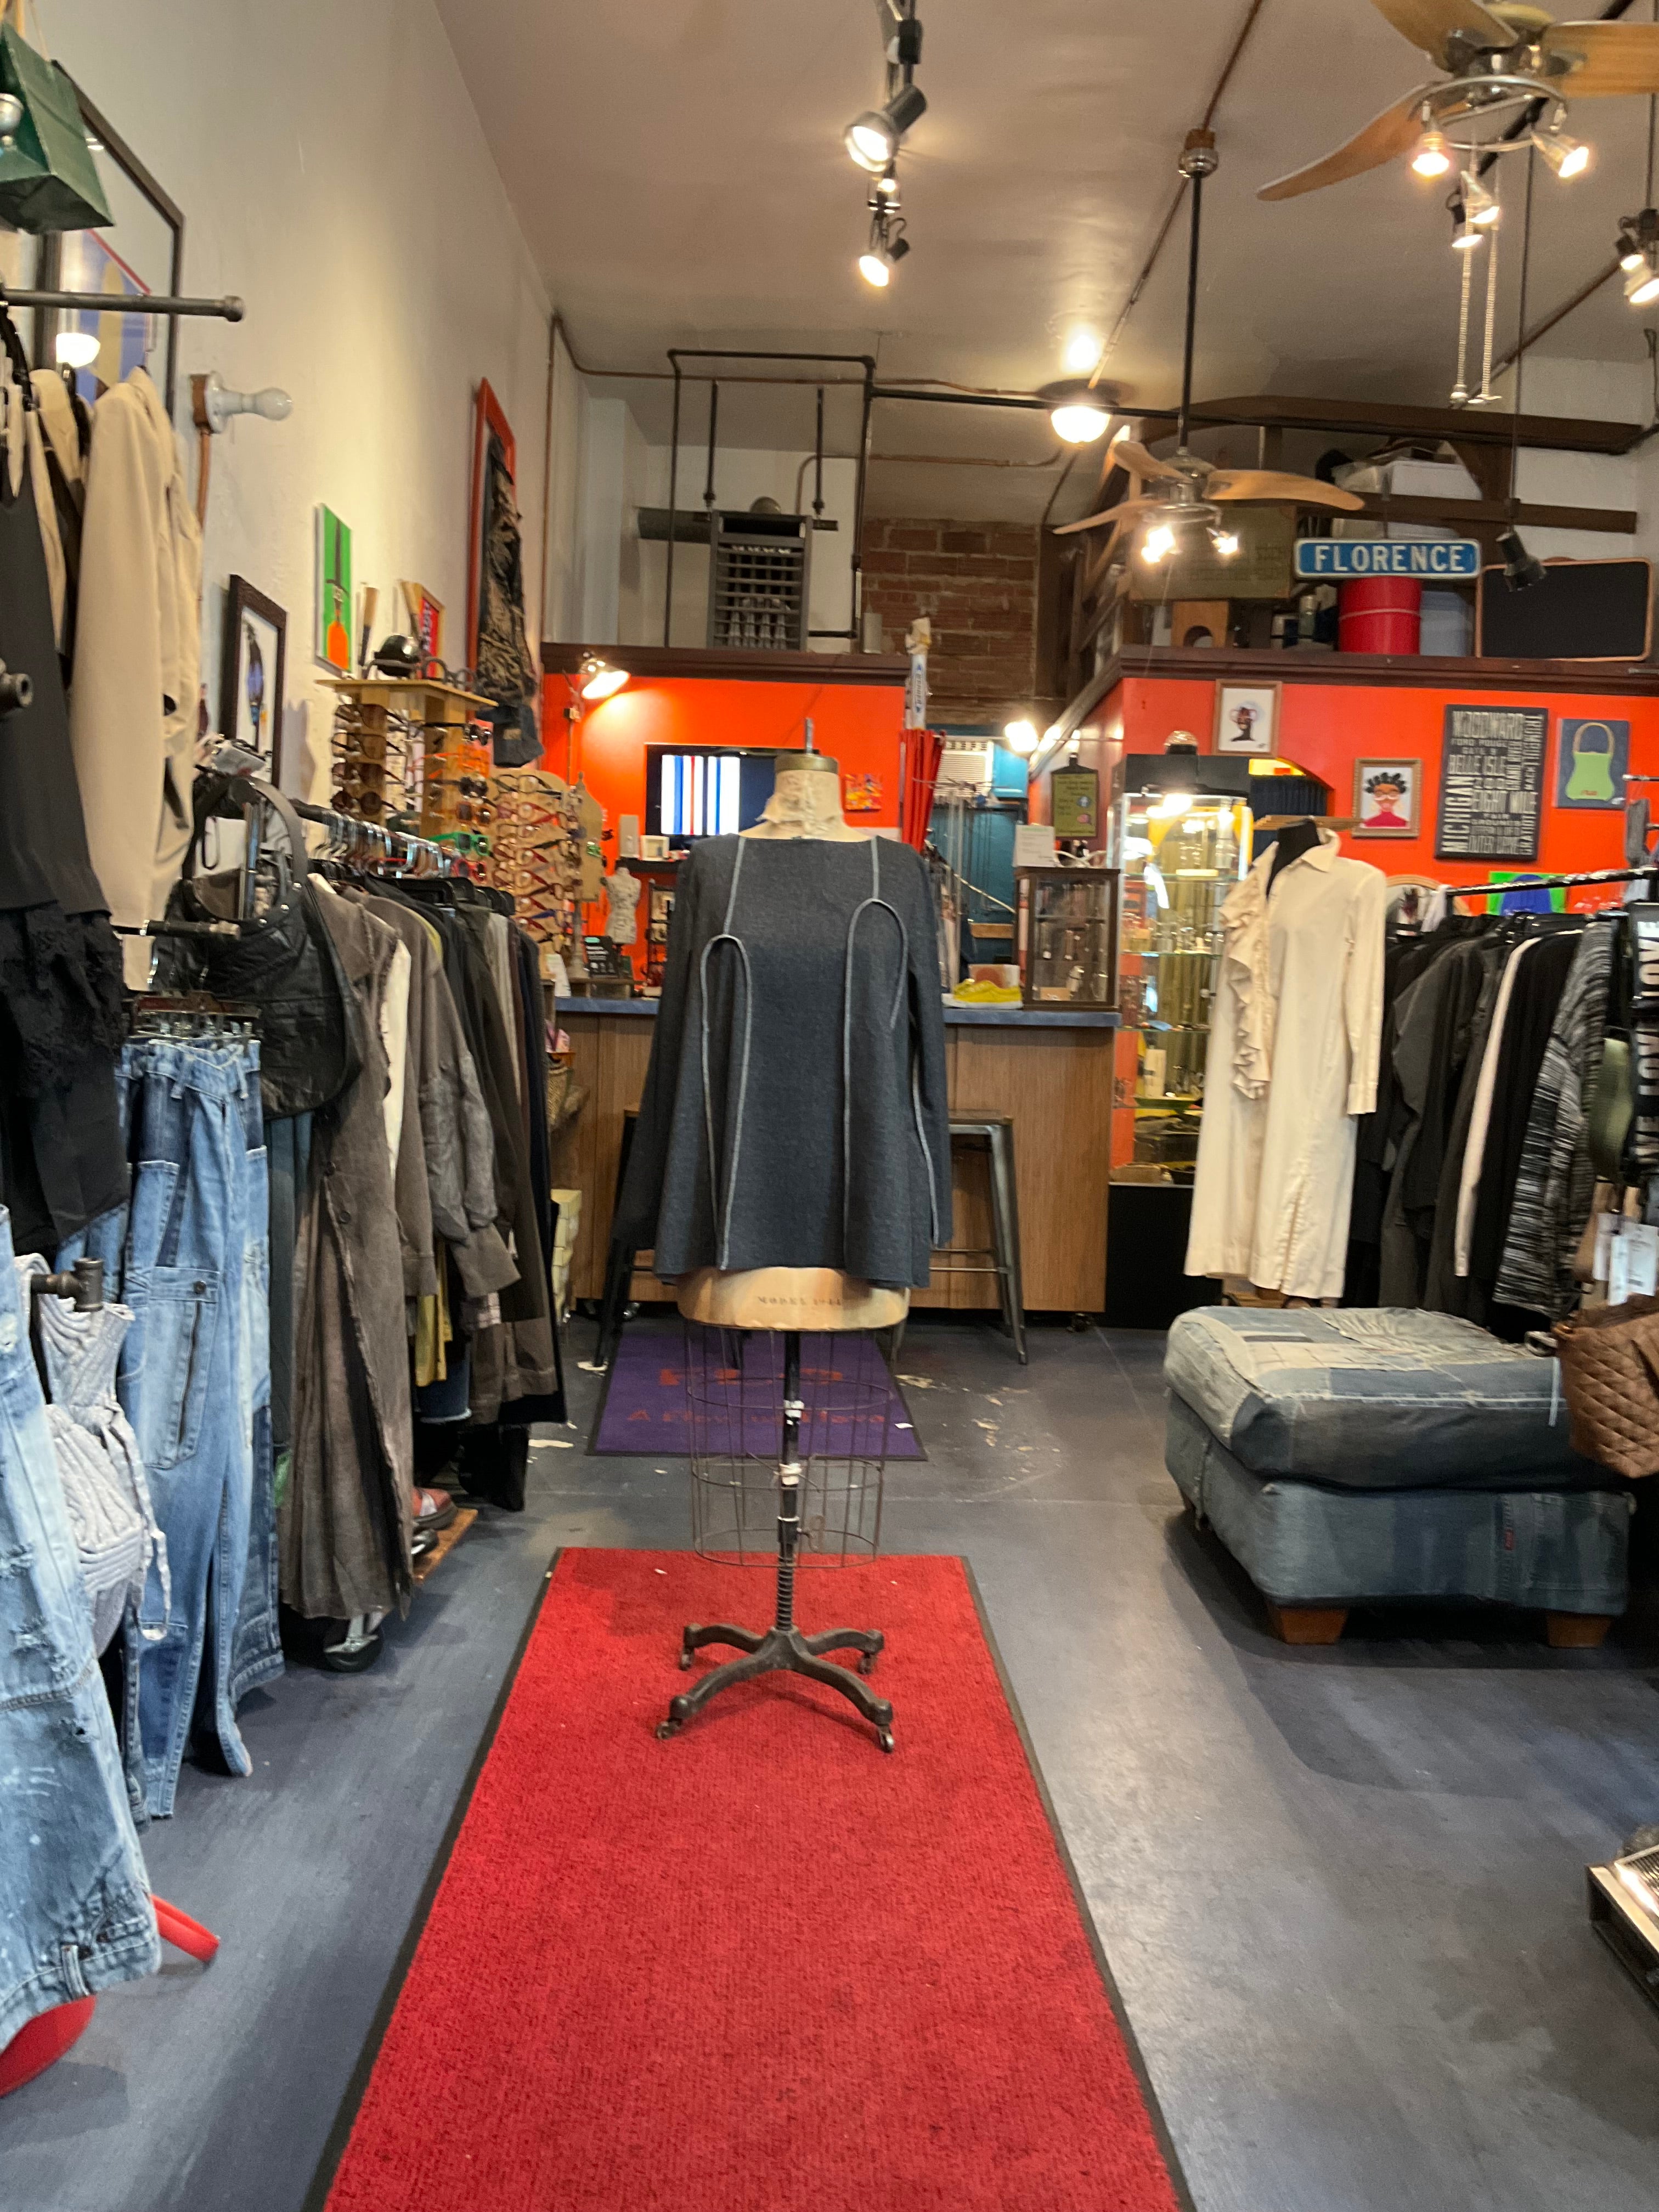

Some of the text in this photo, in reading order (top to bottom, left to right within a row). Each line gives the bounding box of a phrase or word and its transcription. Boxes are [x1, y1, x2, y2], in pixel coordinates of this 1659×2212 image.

[1314, 546, 1466, 572] FLORENCE
[1452, 711, 1523, 740] WOODWARD
[1448, 754, 1508, 777] BELLE ISLE
[1441, 776, 1475, 853] MICHIGAN
[1472, 789, 1509, 813] EIGHT
[1518, 814, 1536, 855] GRATIOT
